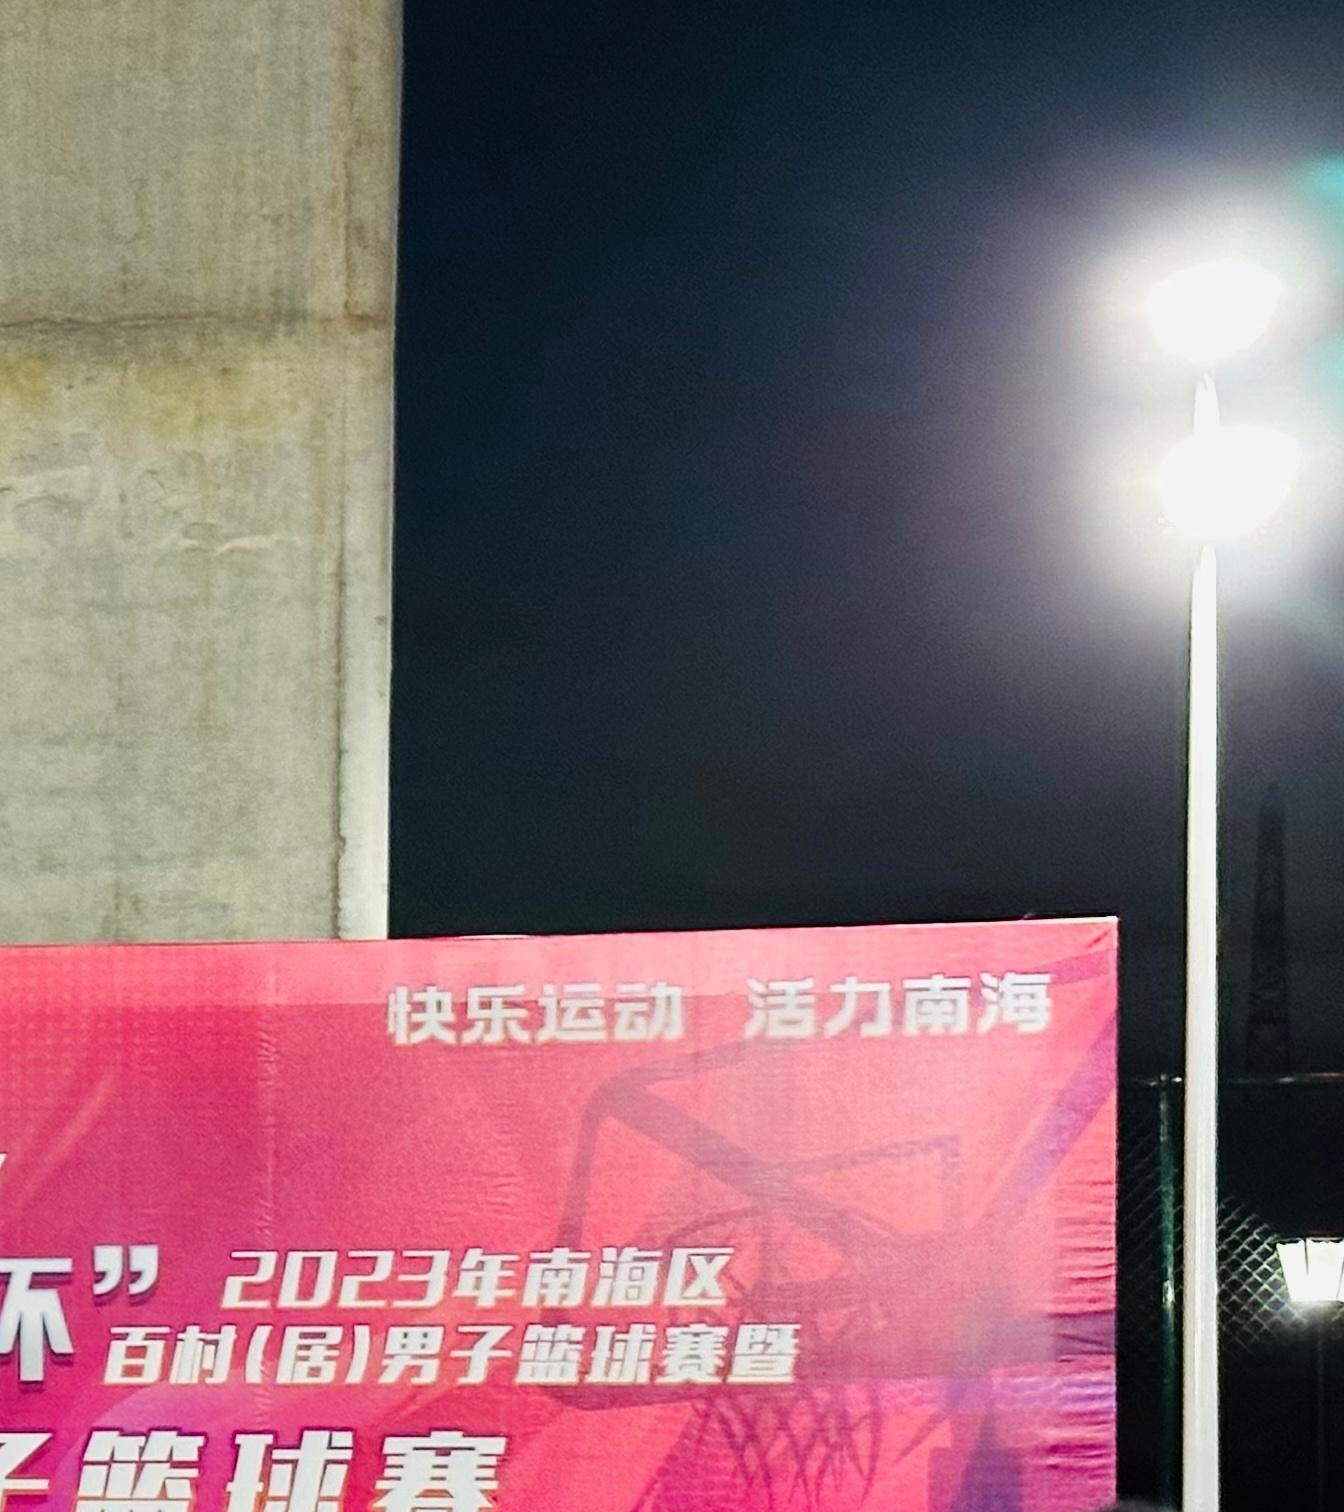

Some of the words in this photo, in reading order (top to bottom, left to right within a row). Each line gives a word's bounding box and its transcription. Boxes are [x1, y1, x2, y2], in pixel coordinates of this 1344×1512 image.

[387, 982, 684, 1045] 快乐运动
[743, 972, 1052, 1038] 活力南海
[220, 1246, 735, 1310] 2023年南海区
[102, 1323, 802, 1384] 百村(居)男子篮球赛暨
